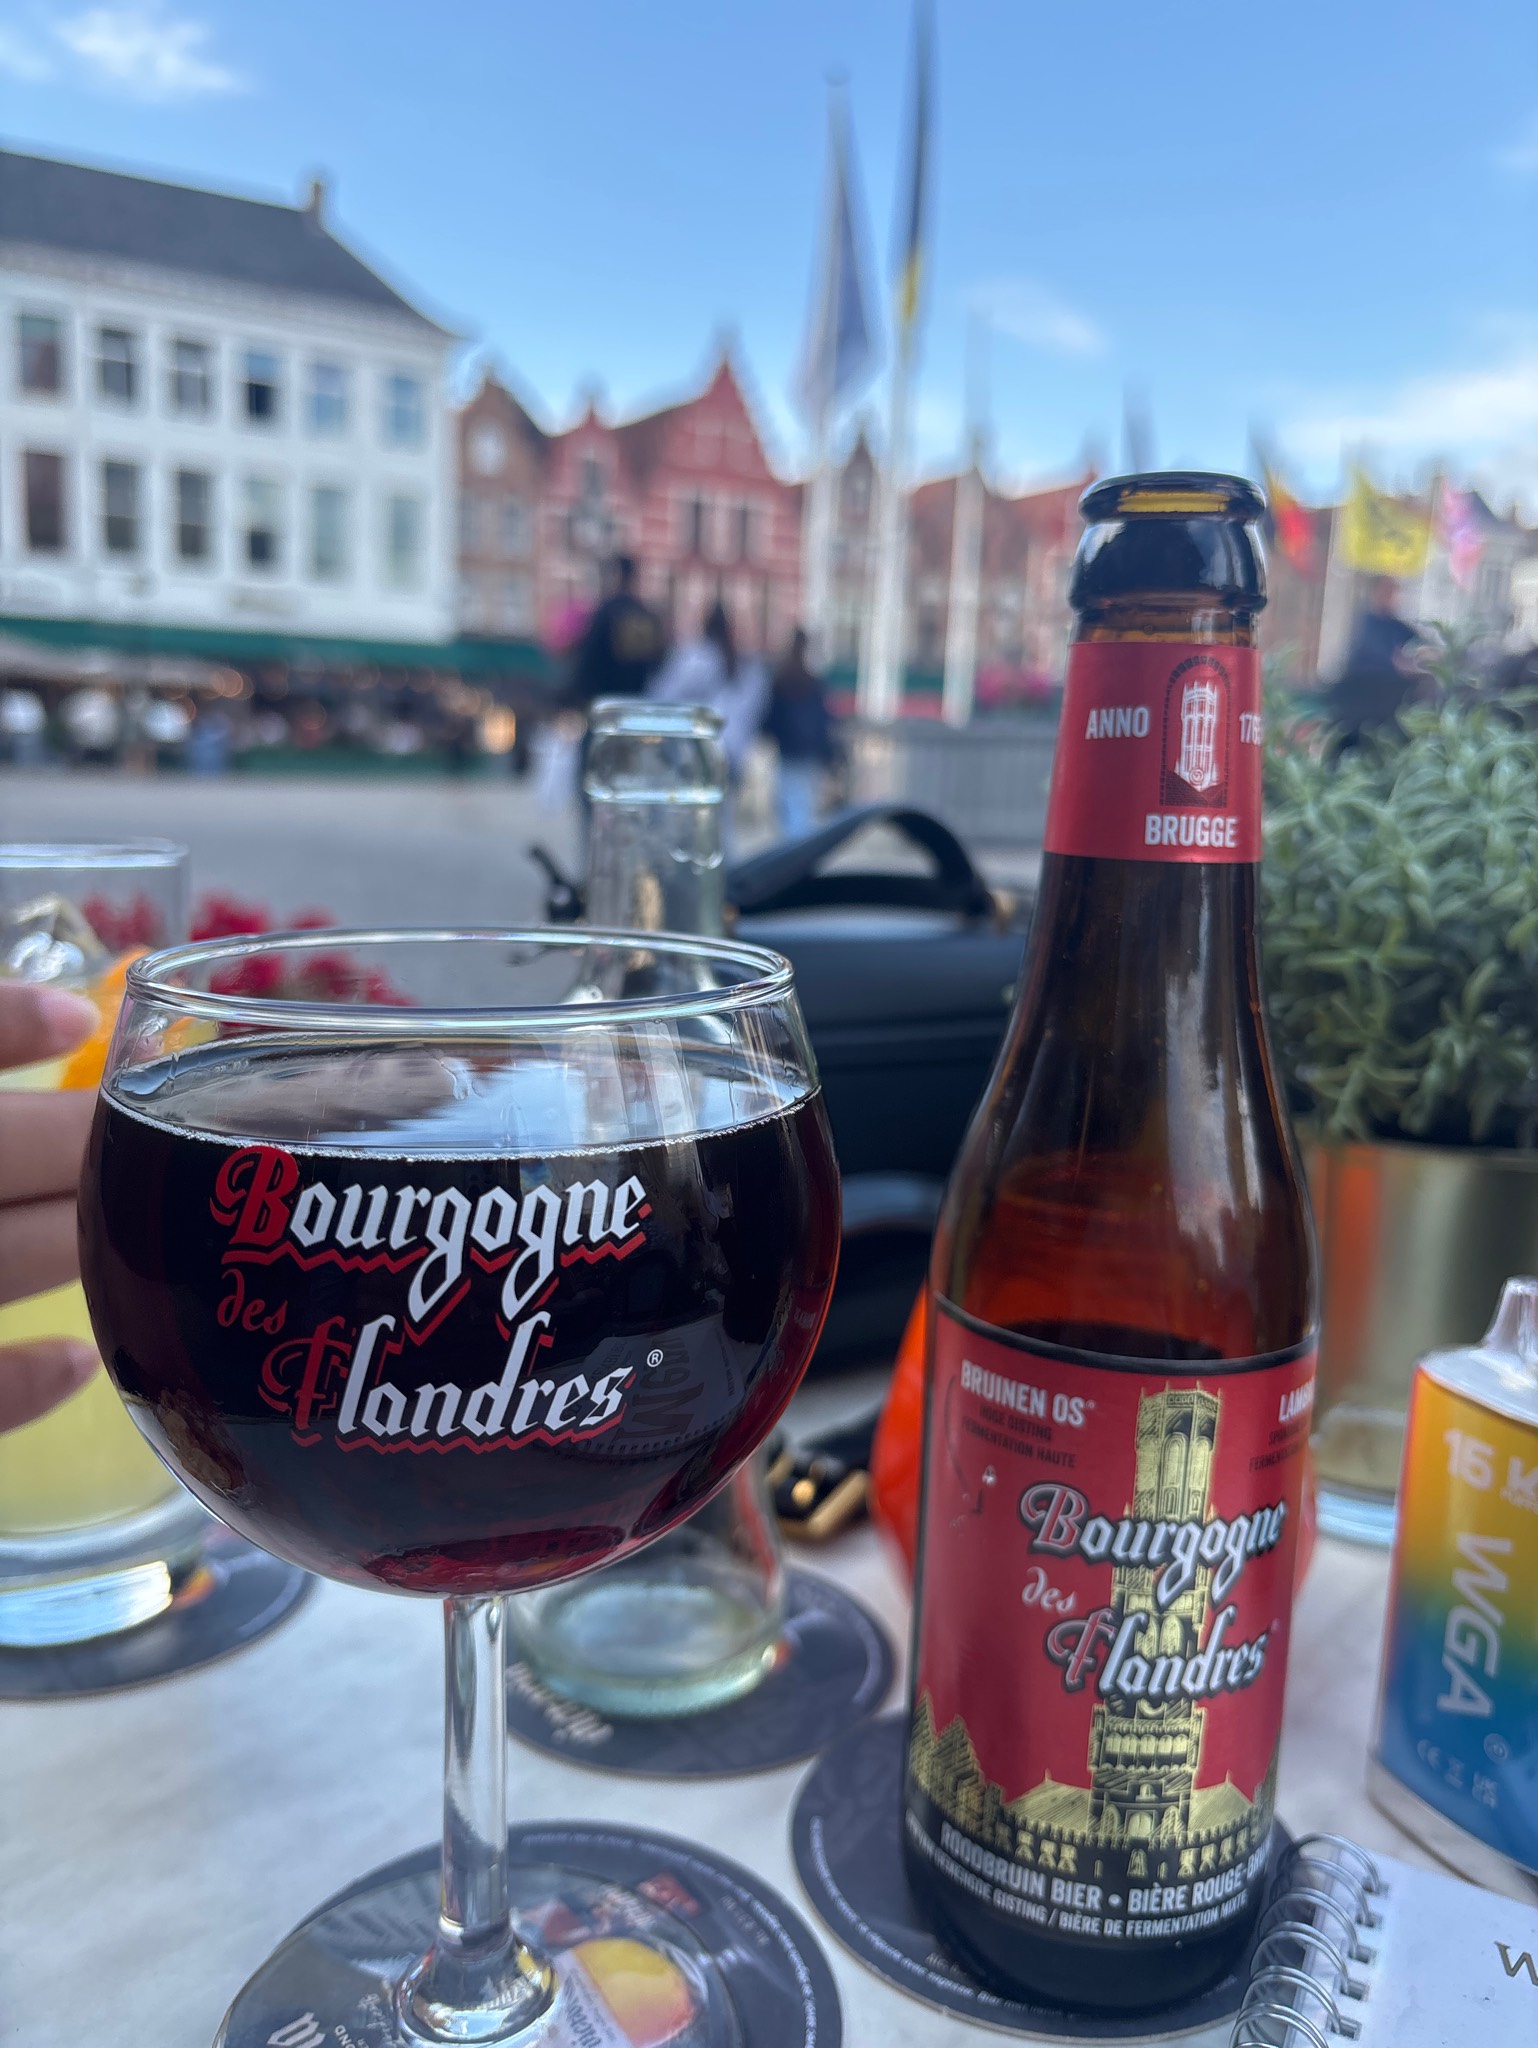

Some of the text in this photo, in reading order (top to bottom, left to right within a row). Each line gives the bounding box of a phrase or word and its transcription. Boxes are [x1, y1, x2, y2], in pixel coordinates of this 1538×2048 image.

[1085, 706, 1150, 740] ANNO
[1144, 813, 1238, 848] BRUGGE
[211, 1145, 650, 1323] Bourgogne
[217, 1269, 286, 1334] des
[961, 1360, 1045, 1418] BRUINEN
[1008, 1415, 1053, 1442] GISTING
[1037, 1446, 1076, 1469] HAUTE
[1020, 1482, 1287, 1613] Bourgogne
[1022, 1566, 1075, 1613] des
[1437, 1532, 1513, 1718] WGA
[941, 1820, 1047, 1900] ROODBRUIN
[1051, 1878, 1102, 1910] BIER
[1127, 1881, 1188, 1914] BIÈRE
[993, 1888, 1048, 1924] GISTING
[1058, 1909, 1101, 1935] BIÈRE
[1104, 1917, 1123, 1937] DE
[1126, 1904, 1220, 1938] FERMENTATION
[1220, 1888, 1248, 1919] MIXTE
